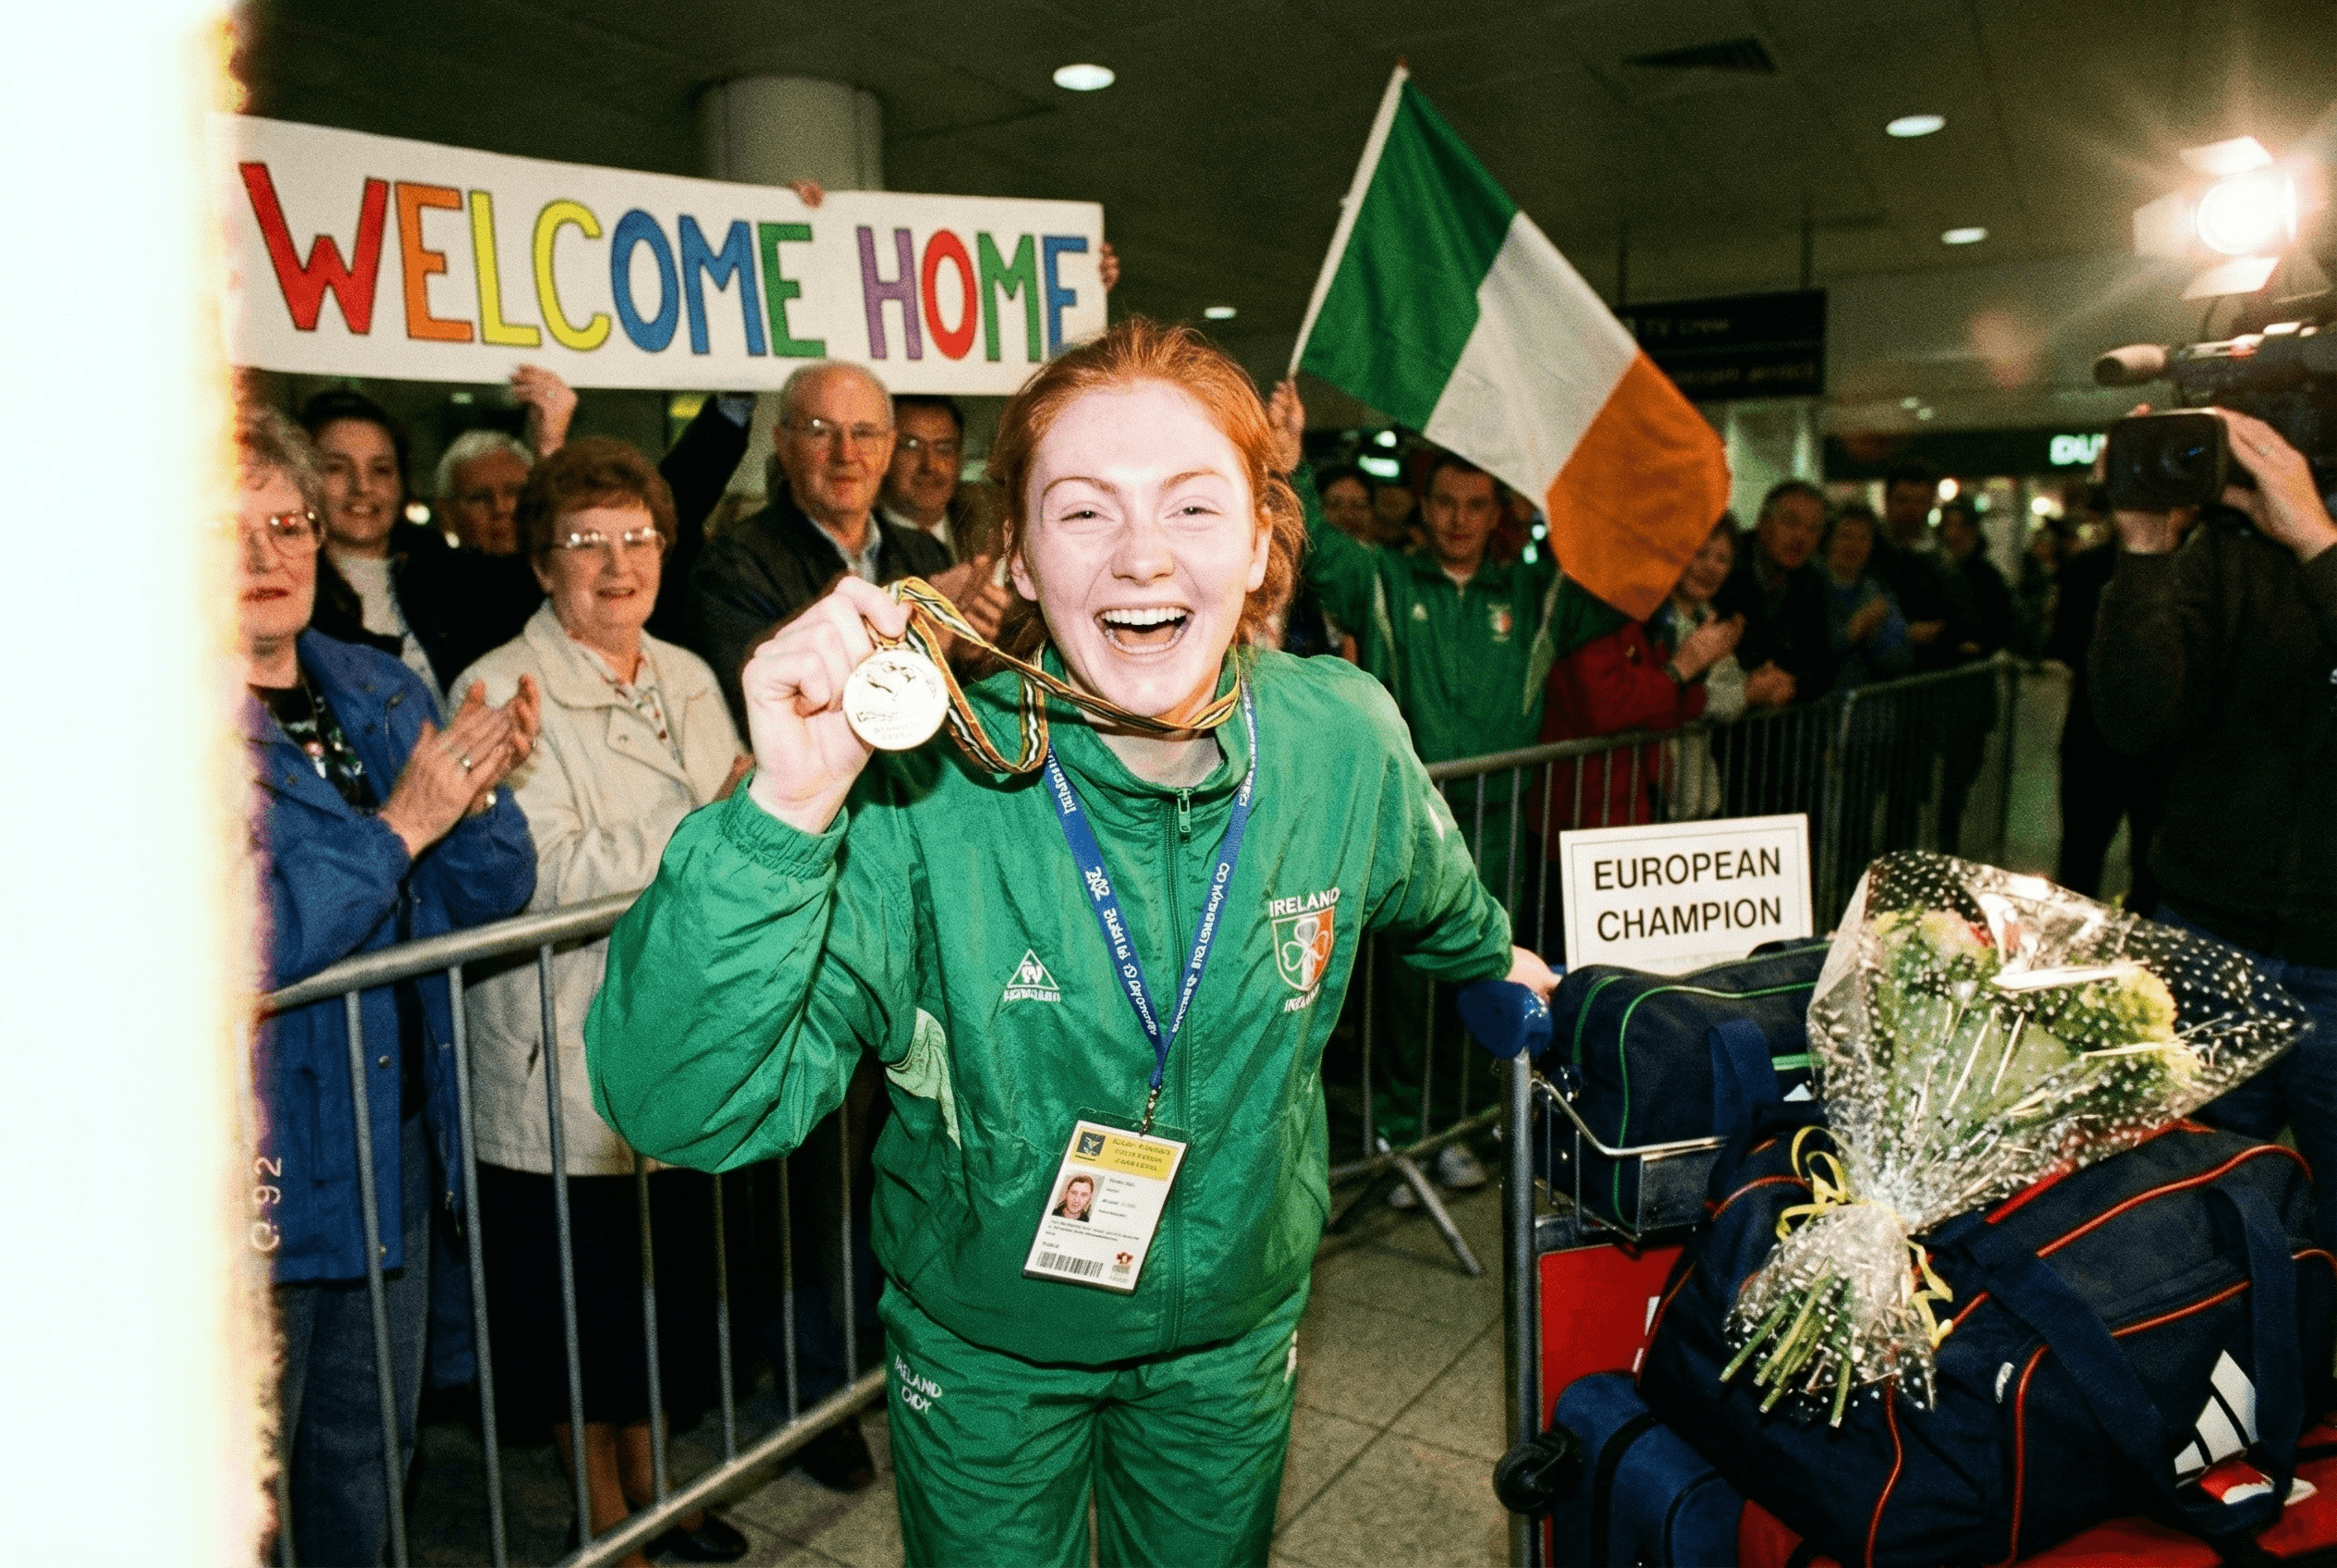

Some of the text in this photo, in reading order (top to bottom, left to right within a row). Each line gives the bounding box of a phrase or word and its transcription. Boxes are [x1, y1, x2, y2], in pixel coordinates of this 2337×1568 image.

[239, 162, 1089, 363] WELCOME HOME
[2049, 433, 2107, 465] DU
[1594, 847, 1781, 890] EUROPEAN
[1269, 887, 1340, 917] IRELAND
[1597, 897, 1781, 941] CHAMPION
